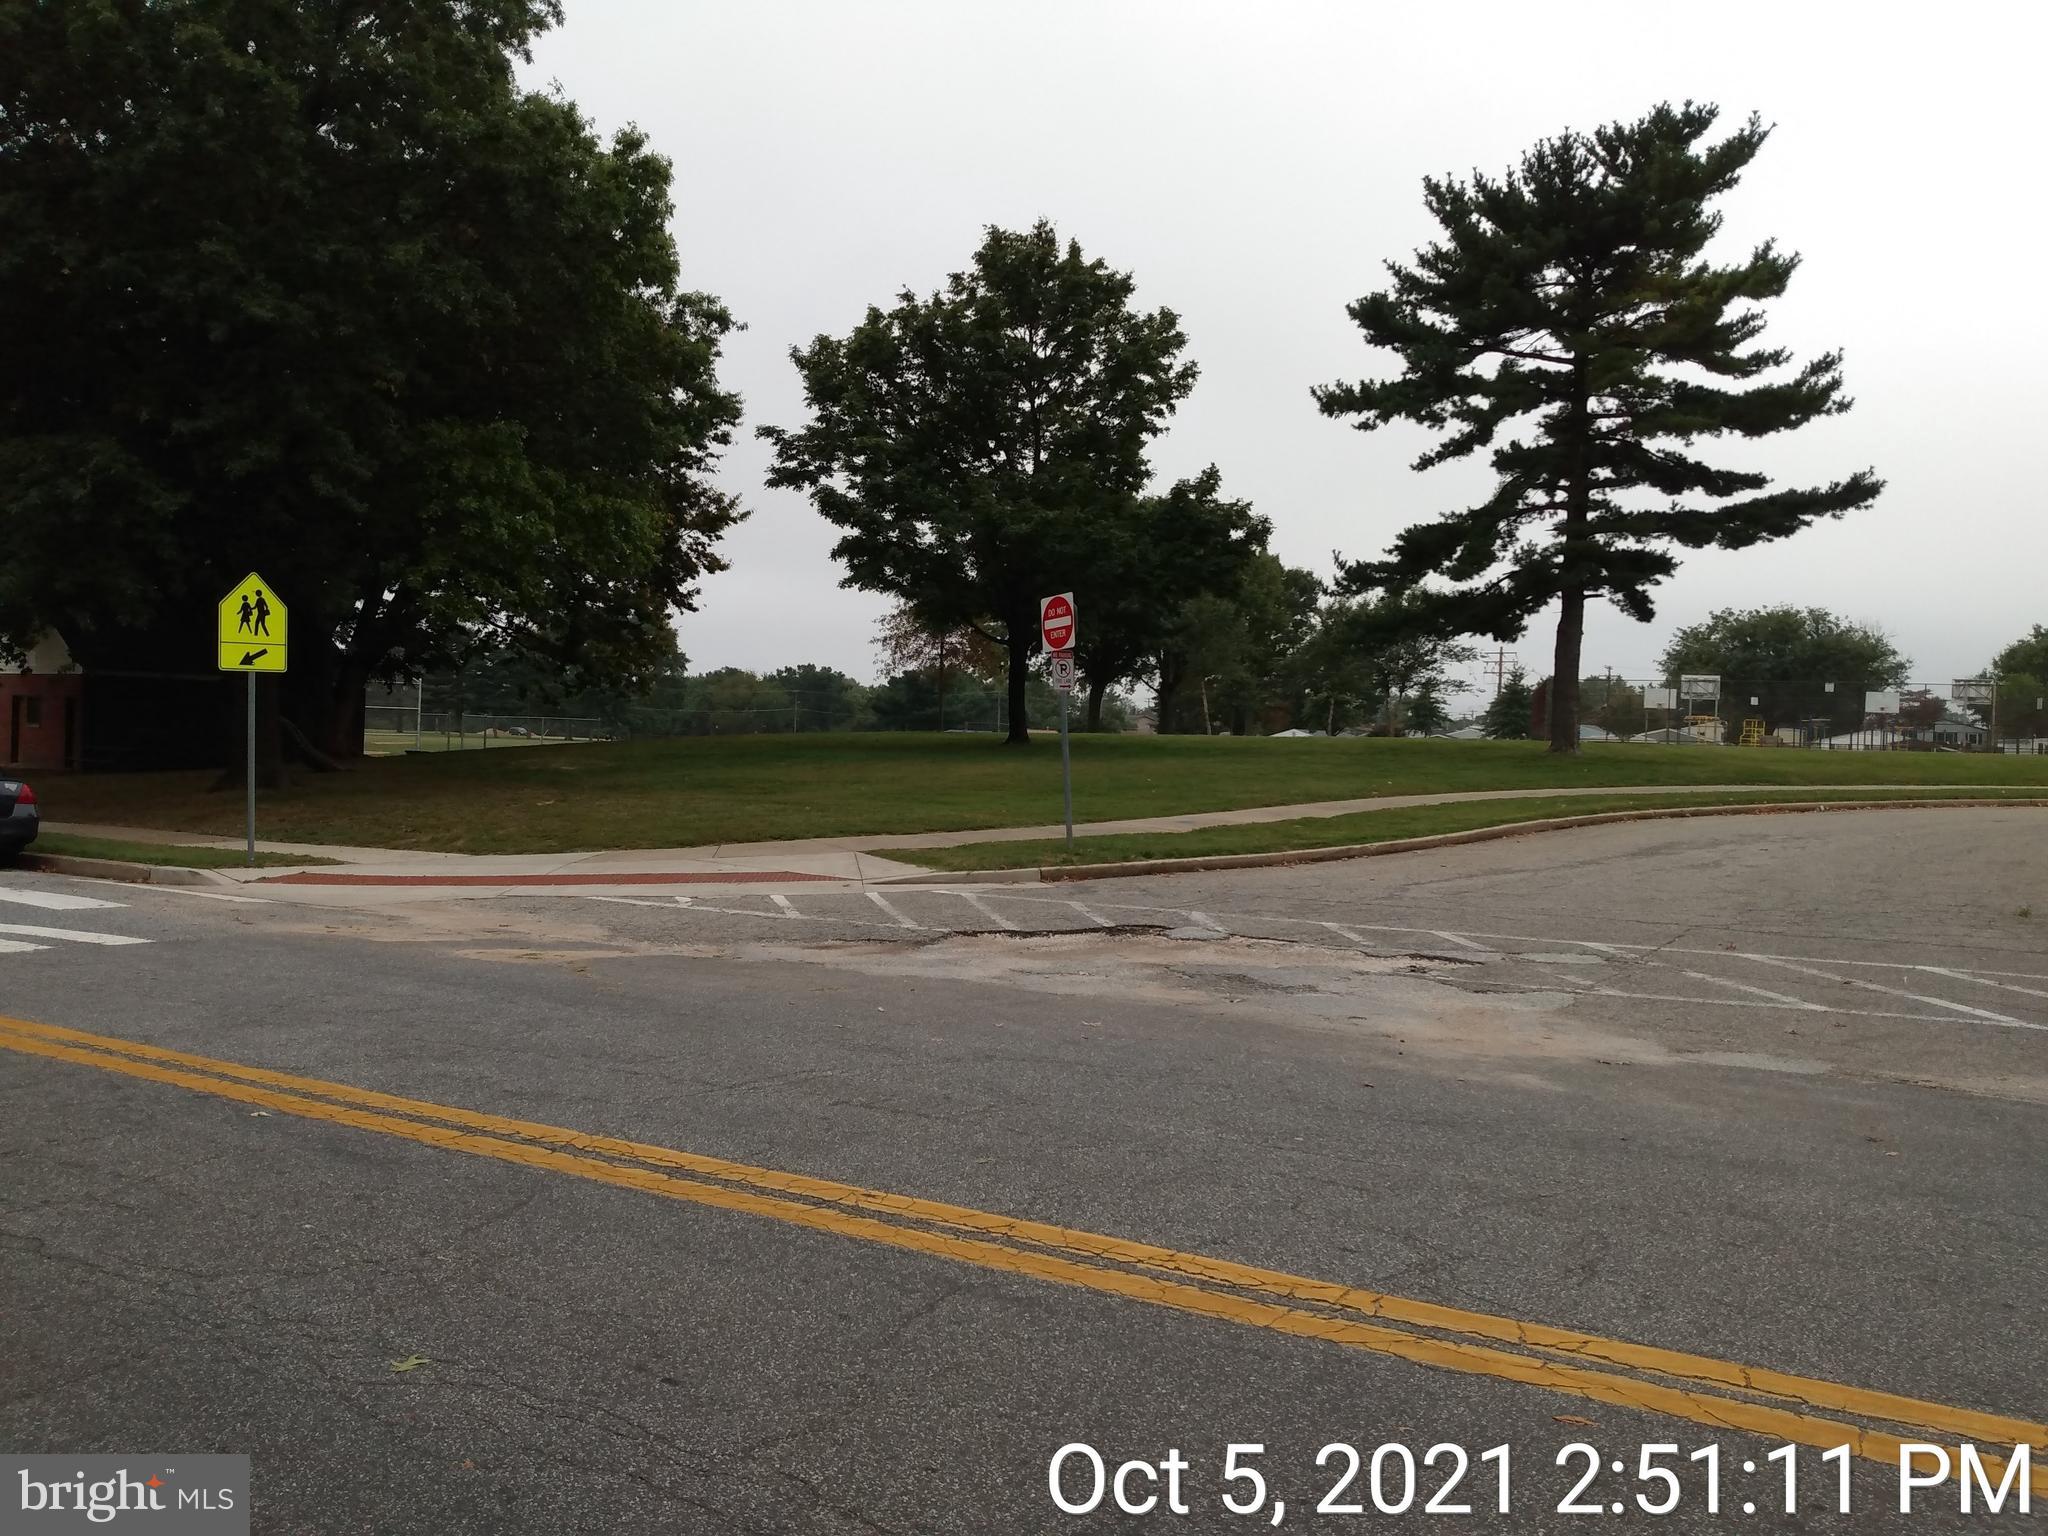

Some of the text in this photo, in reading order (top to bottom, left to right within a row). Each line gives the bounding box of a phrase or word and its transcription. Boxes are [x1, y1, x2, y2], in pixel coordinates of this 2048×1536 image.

[1048, 606, 1066, 617] DO NOT
[1050, 629, 1066, 639] ENTER
